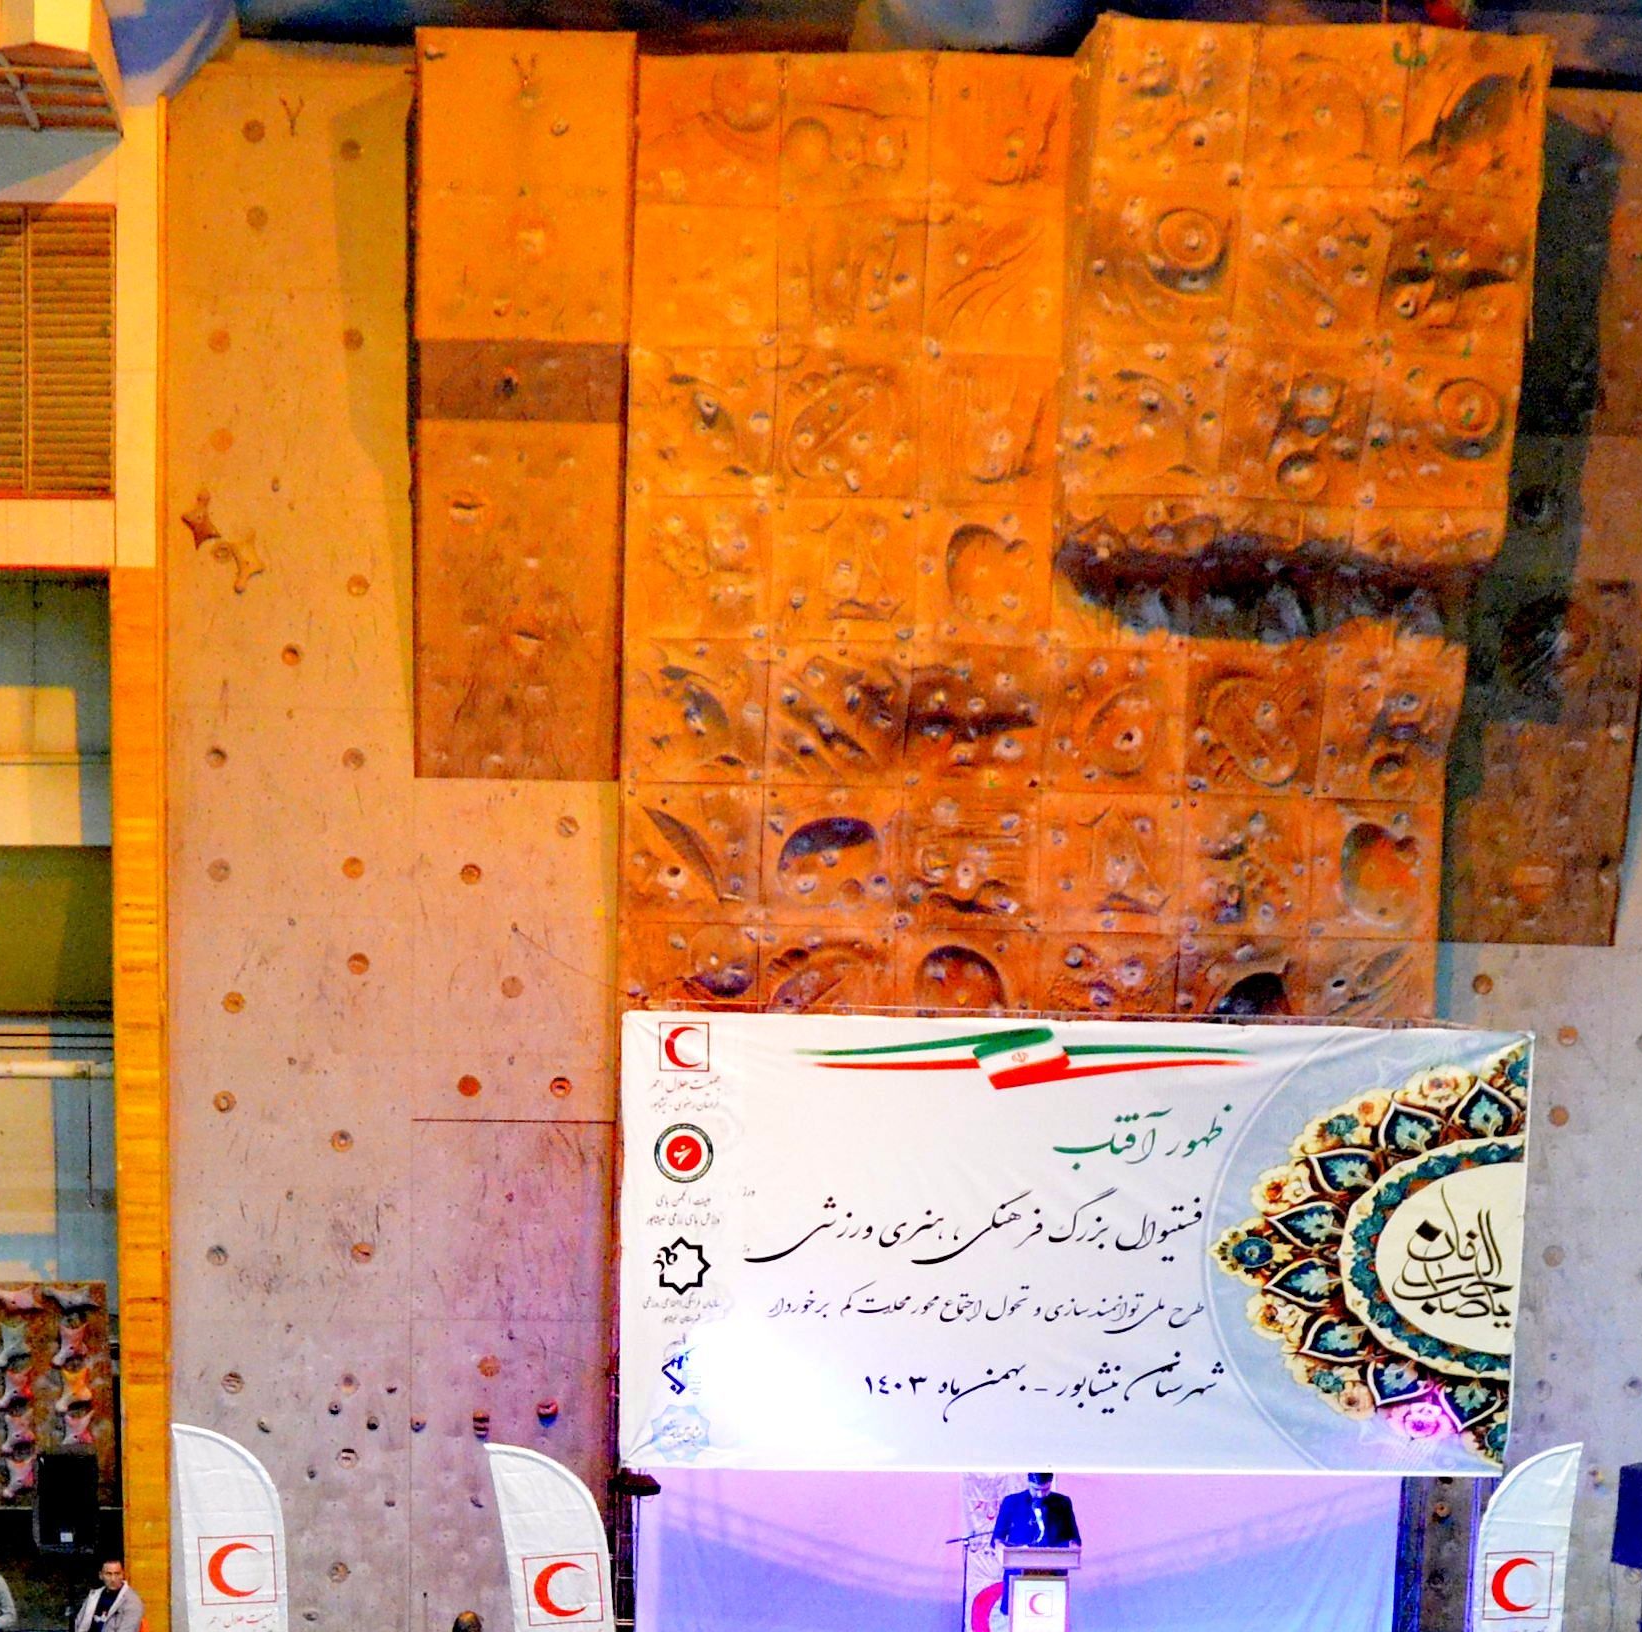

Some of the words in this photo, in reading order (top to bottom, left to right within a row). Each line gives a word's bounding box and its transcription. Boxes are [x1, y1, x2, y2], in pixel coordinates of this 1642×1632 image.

[1052, 1106, 1174, 1171] آفتاب
[1164, 1103, 1232, 1158] ظهور
[743, 1196, 874, 1264] ورزشی
[878, 1209, 945, 1248] هنری
[1047, 1187, 1118, 1250] بزرگ
[1114, 1196, 1203, 1262] فستیوال
[839, 1279, 877, 1318] کم
[910, 1295, 940, 1315] محور
[984, 1284, 1030, 1321] تحول
[1032, 1305, 1042, 1317] و
[1103, 1298, 1165, 1335] ملی
[1168, 1300, 1205, 1329] طرح
[937, 1377, 961, 1397] ماه
[942, 1363, 1027, 1423] بهمن
[1055, 1361, 1122, 1414] نیشابور
[1123, 1350, 1225, 1406] شهرستان
